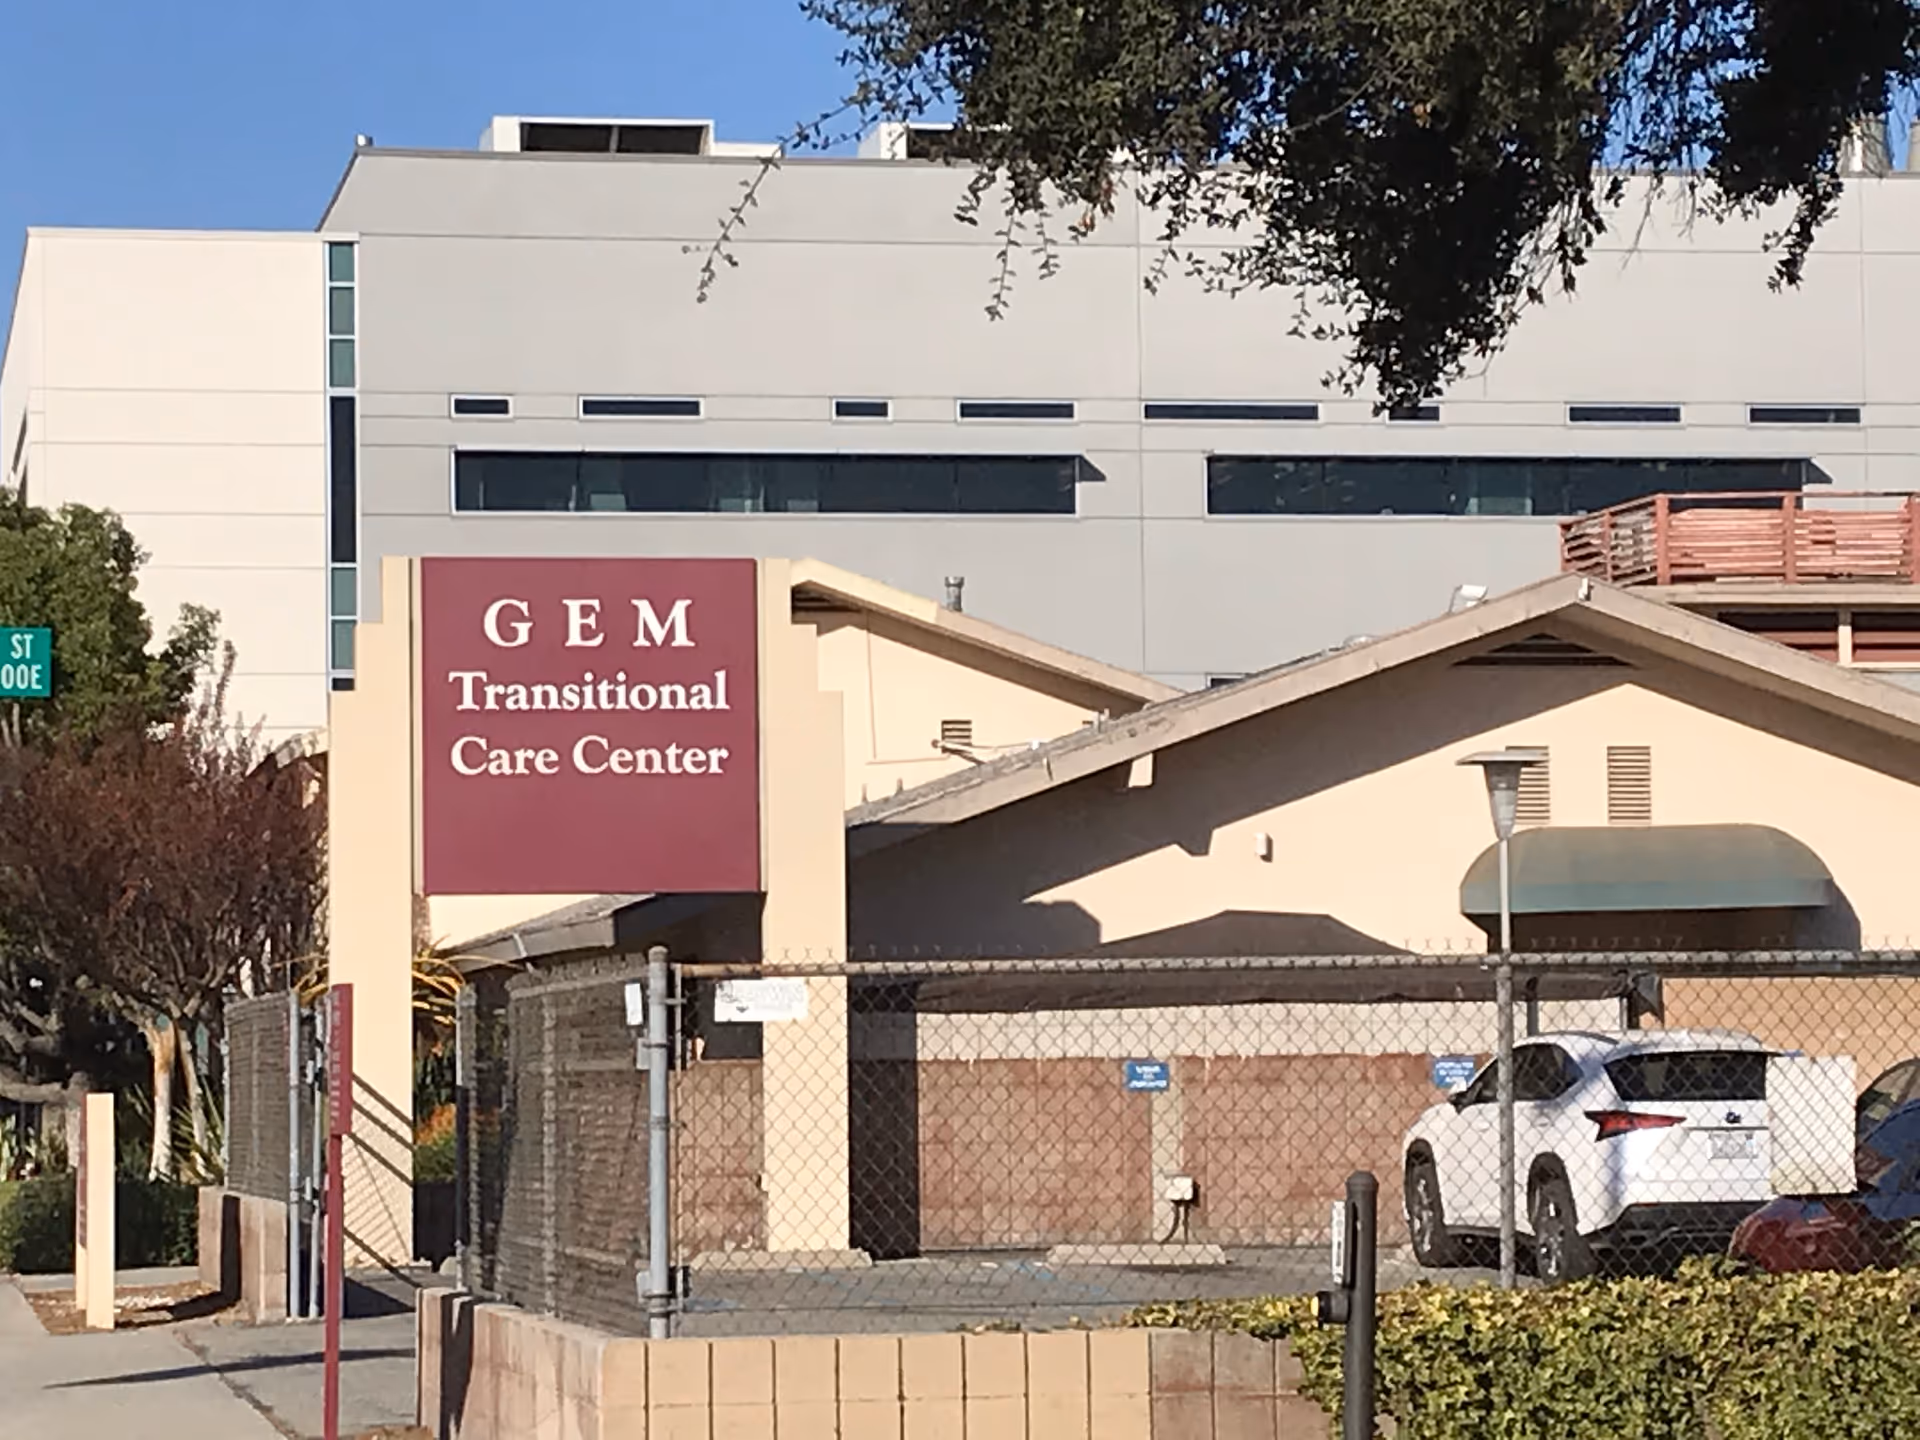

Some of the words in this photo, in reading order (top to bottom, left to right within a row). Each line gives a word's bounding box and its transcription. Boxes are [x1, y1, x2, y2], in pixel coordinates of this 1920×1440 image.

[10, 633, 34, 659] ST
[448, 669, 730, 711] Transitional
[450, 735, 560, 776] Care
[572, 734, 729, 775] Center
